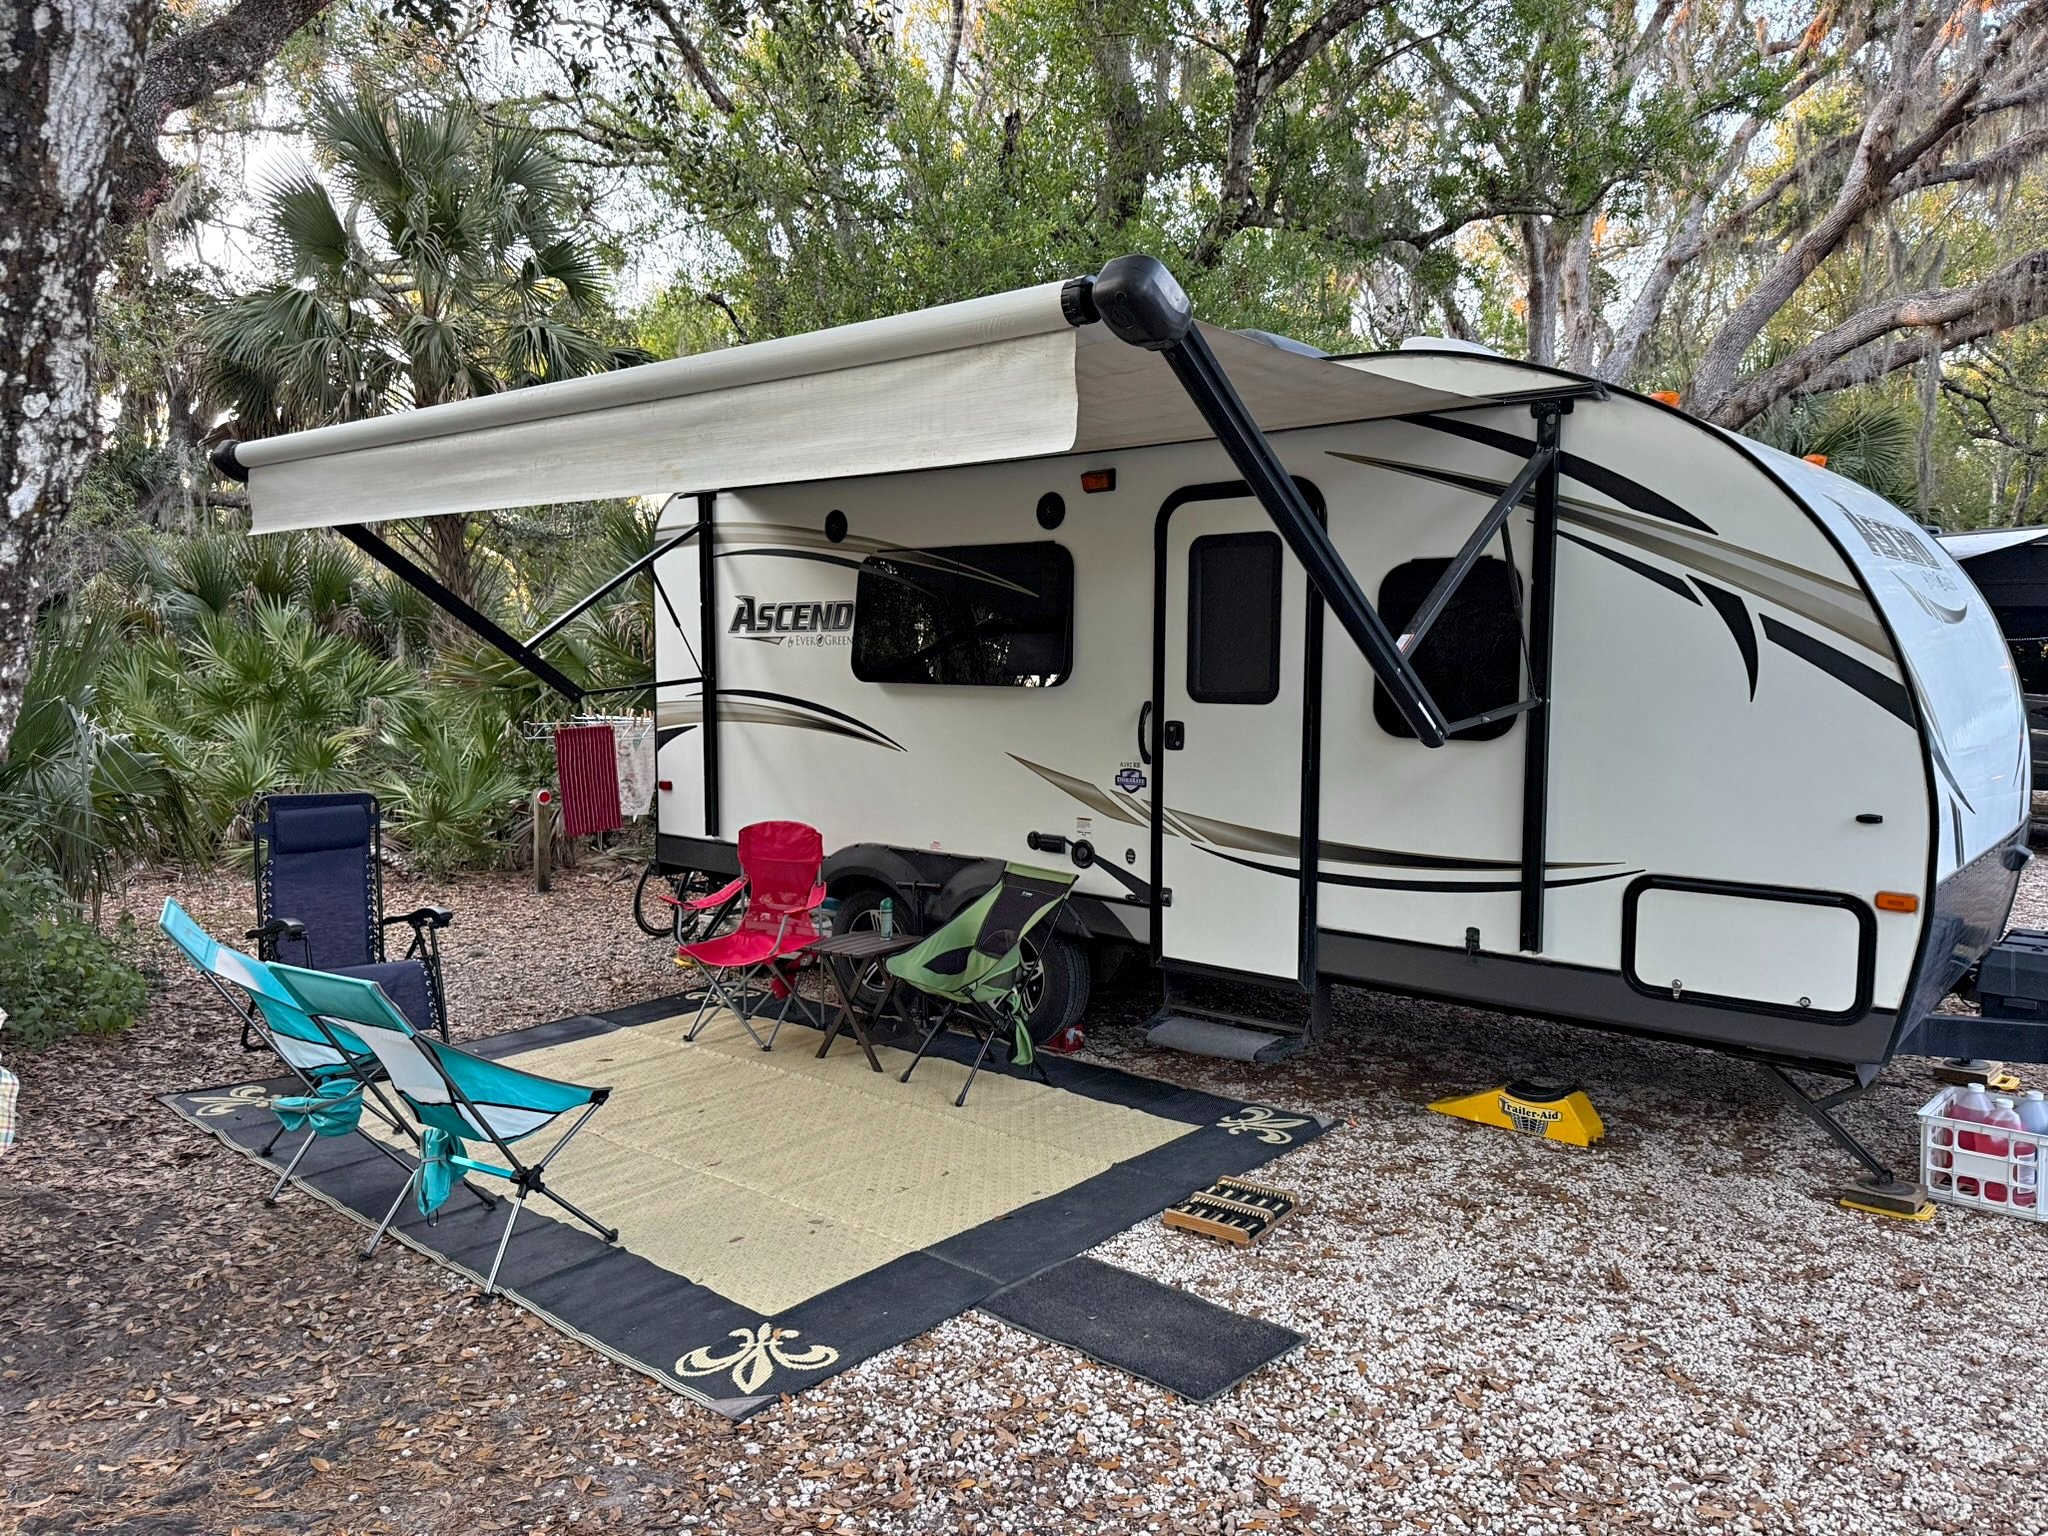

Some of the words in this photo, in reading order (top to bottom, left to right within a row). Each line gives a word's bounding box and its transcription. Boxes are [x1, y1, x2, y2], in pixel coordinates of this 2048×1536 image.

[1826, 495, 1942, 570] ASCEND
[728, 595, 855, 633] ASCEND
[1499, 1096, 1559, 1120] Trailer-Aid
